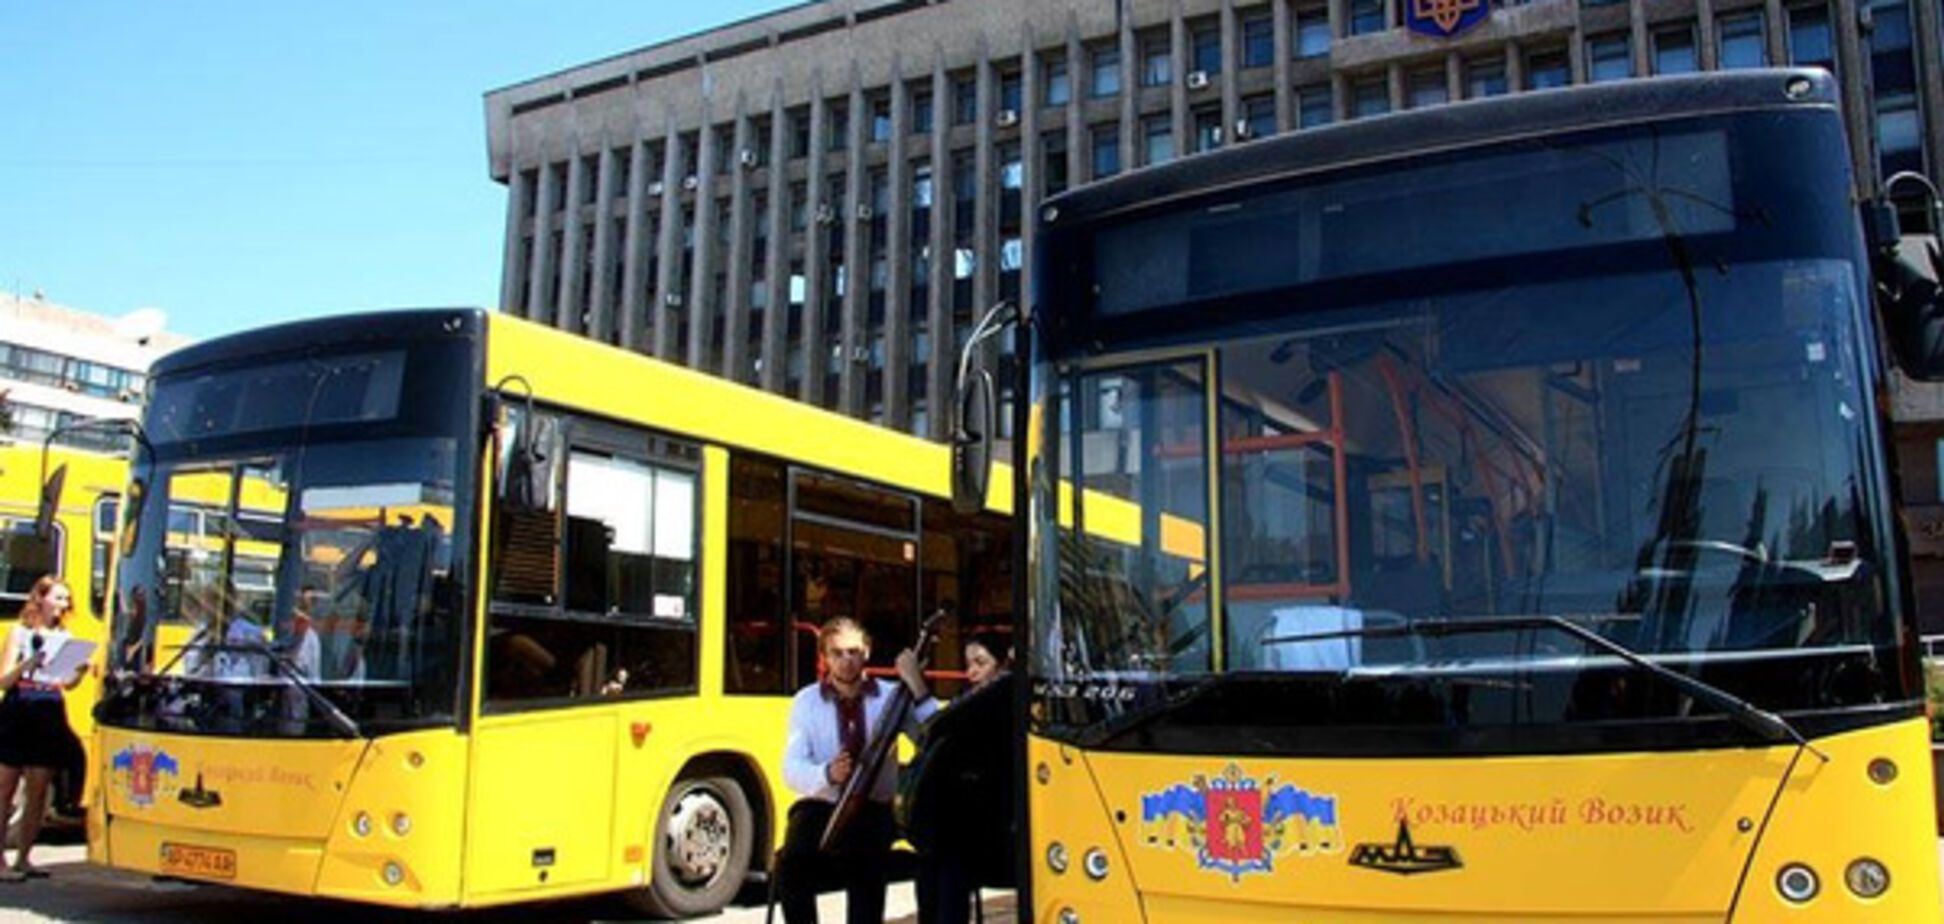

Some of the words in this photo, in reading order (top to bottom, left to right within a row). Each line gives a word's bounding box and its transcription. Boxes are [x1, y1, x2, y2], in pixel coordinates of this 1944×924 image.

[1083, 684, 1137, 701] 206
[1390, 796, 1567, 833] Козацький
[1578, 796, 1696, 834] Возик
